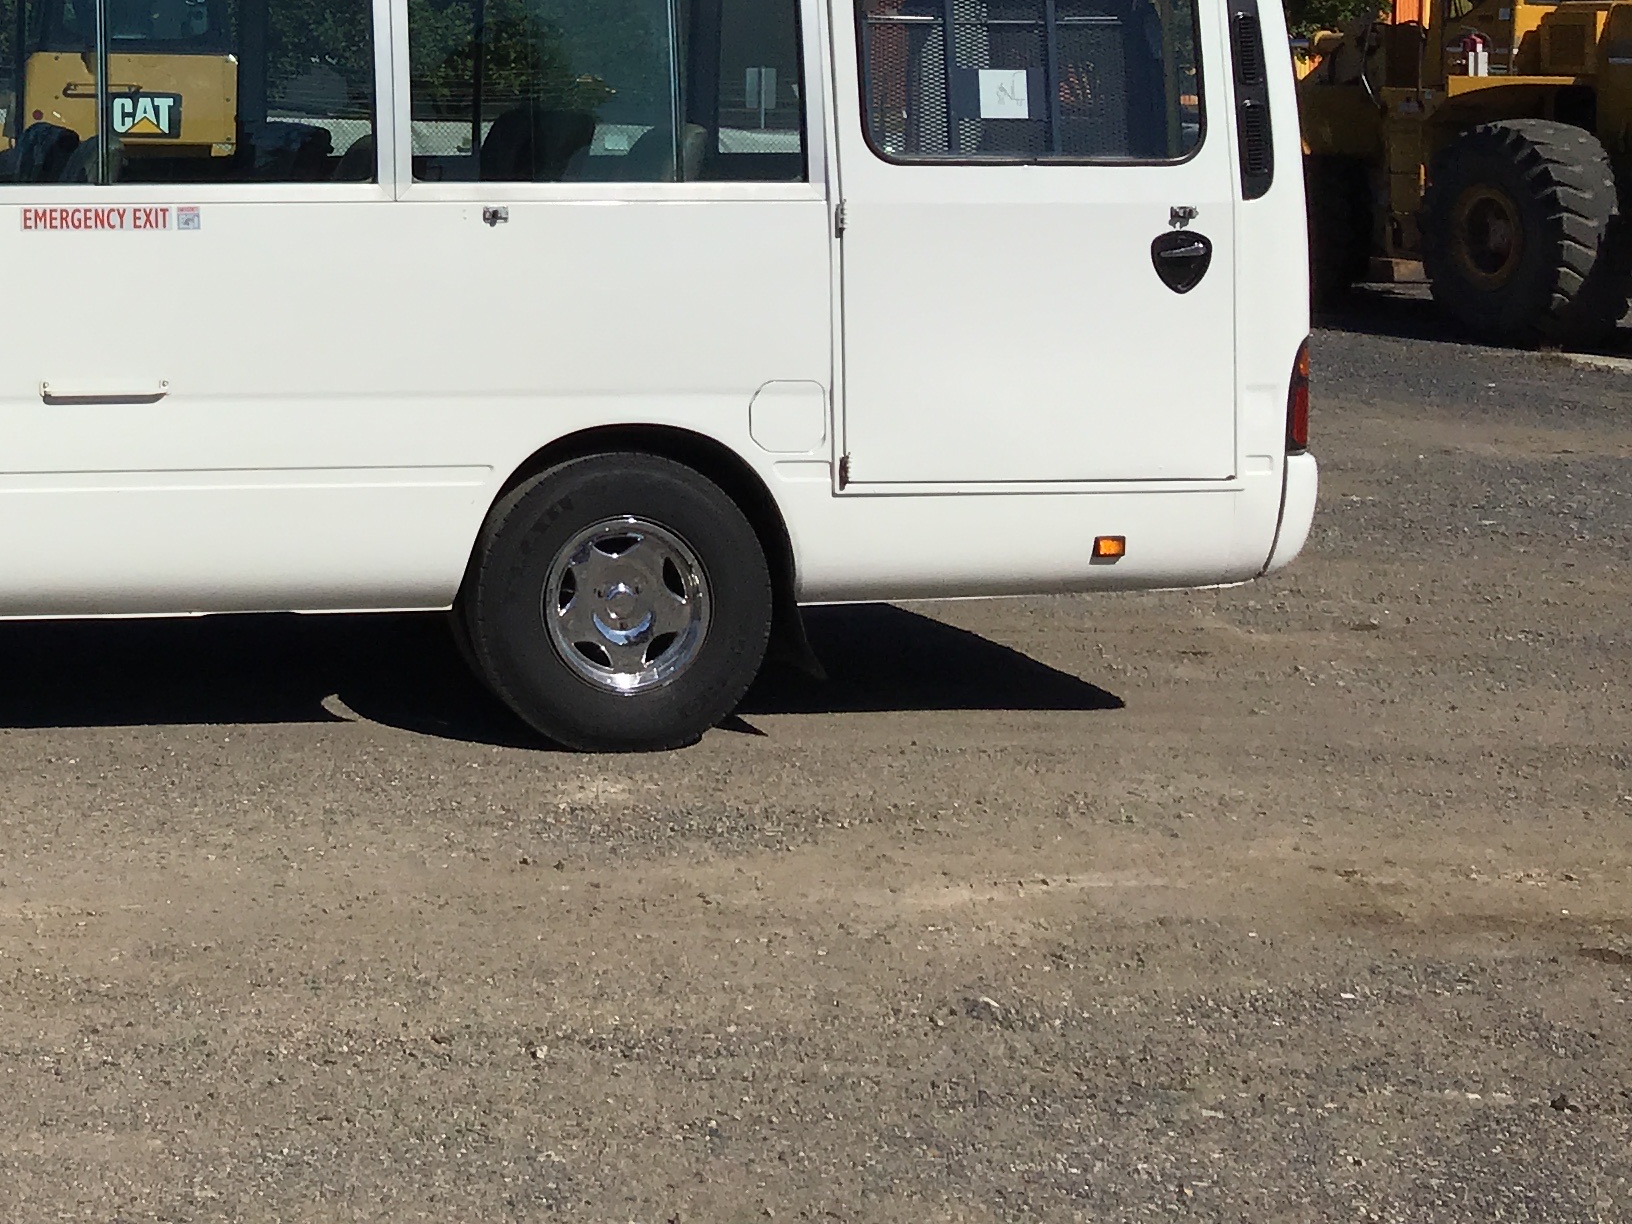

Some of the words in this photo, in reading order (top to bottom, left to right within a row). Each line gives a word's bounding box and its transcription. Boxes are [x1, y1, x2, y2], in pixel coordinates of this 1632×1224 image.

[113, 97, 174, 134] CAT
[23, 208, 126, 230] EMERGENCY
[132, 208, 169, 229] EXIT
